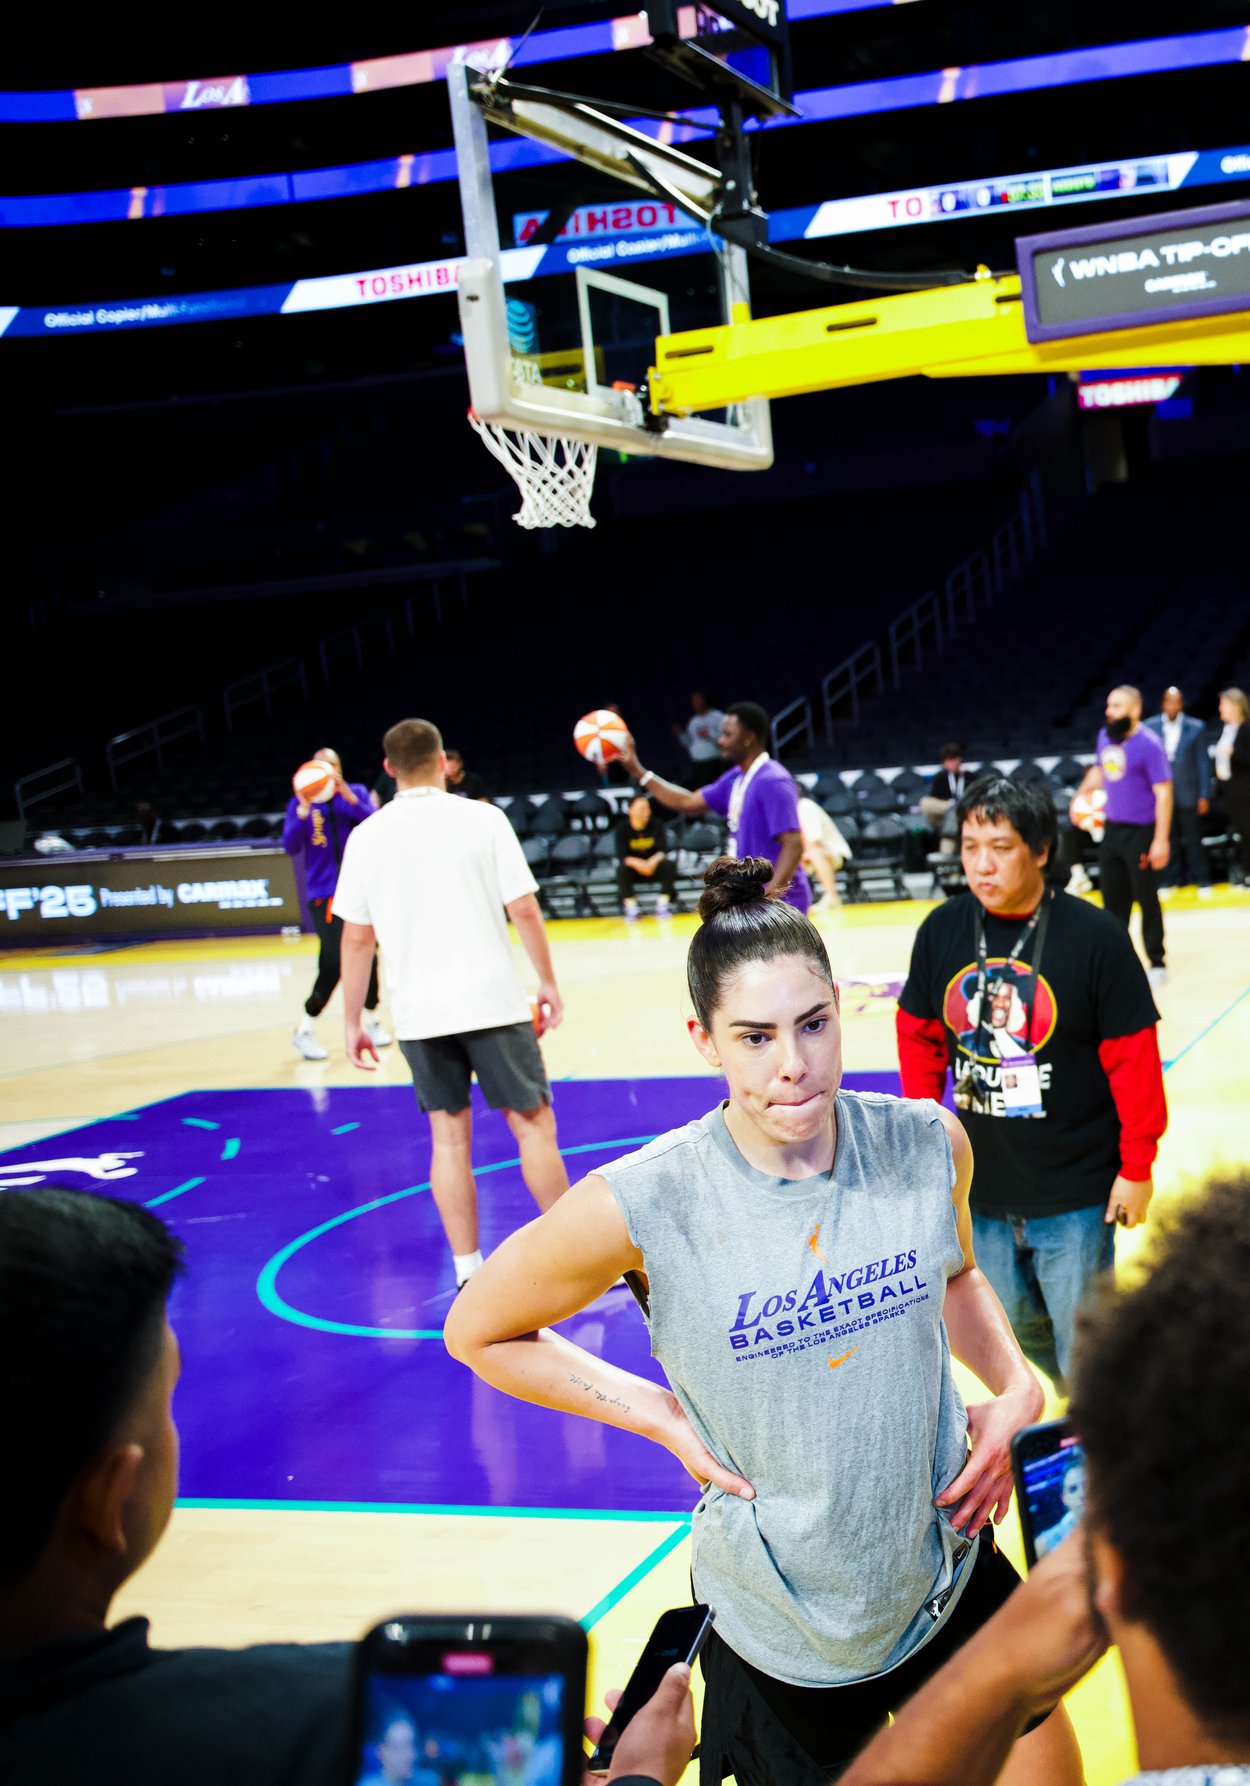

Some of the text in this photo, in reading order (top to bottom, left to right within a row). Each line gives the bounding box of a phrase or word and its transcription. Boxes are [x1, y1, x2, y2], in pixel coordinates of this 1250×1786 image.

[1069, 249, 1160, 280] WNBA
[44, 310, 95, 328] Official
[0, 884, 97, 920] F'25
[99, 885, 157, 908] Presented
[157, 884, 175, 909] by
[729, 1275, 927, 1350] BASKETBALL
[735, 1293, 929, 1362] ENGINEERED TO THE EXACT SPECIFICATIONS
[771, 1309, 906, 1360] OF THE LOS ANGELES SPARKS
